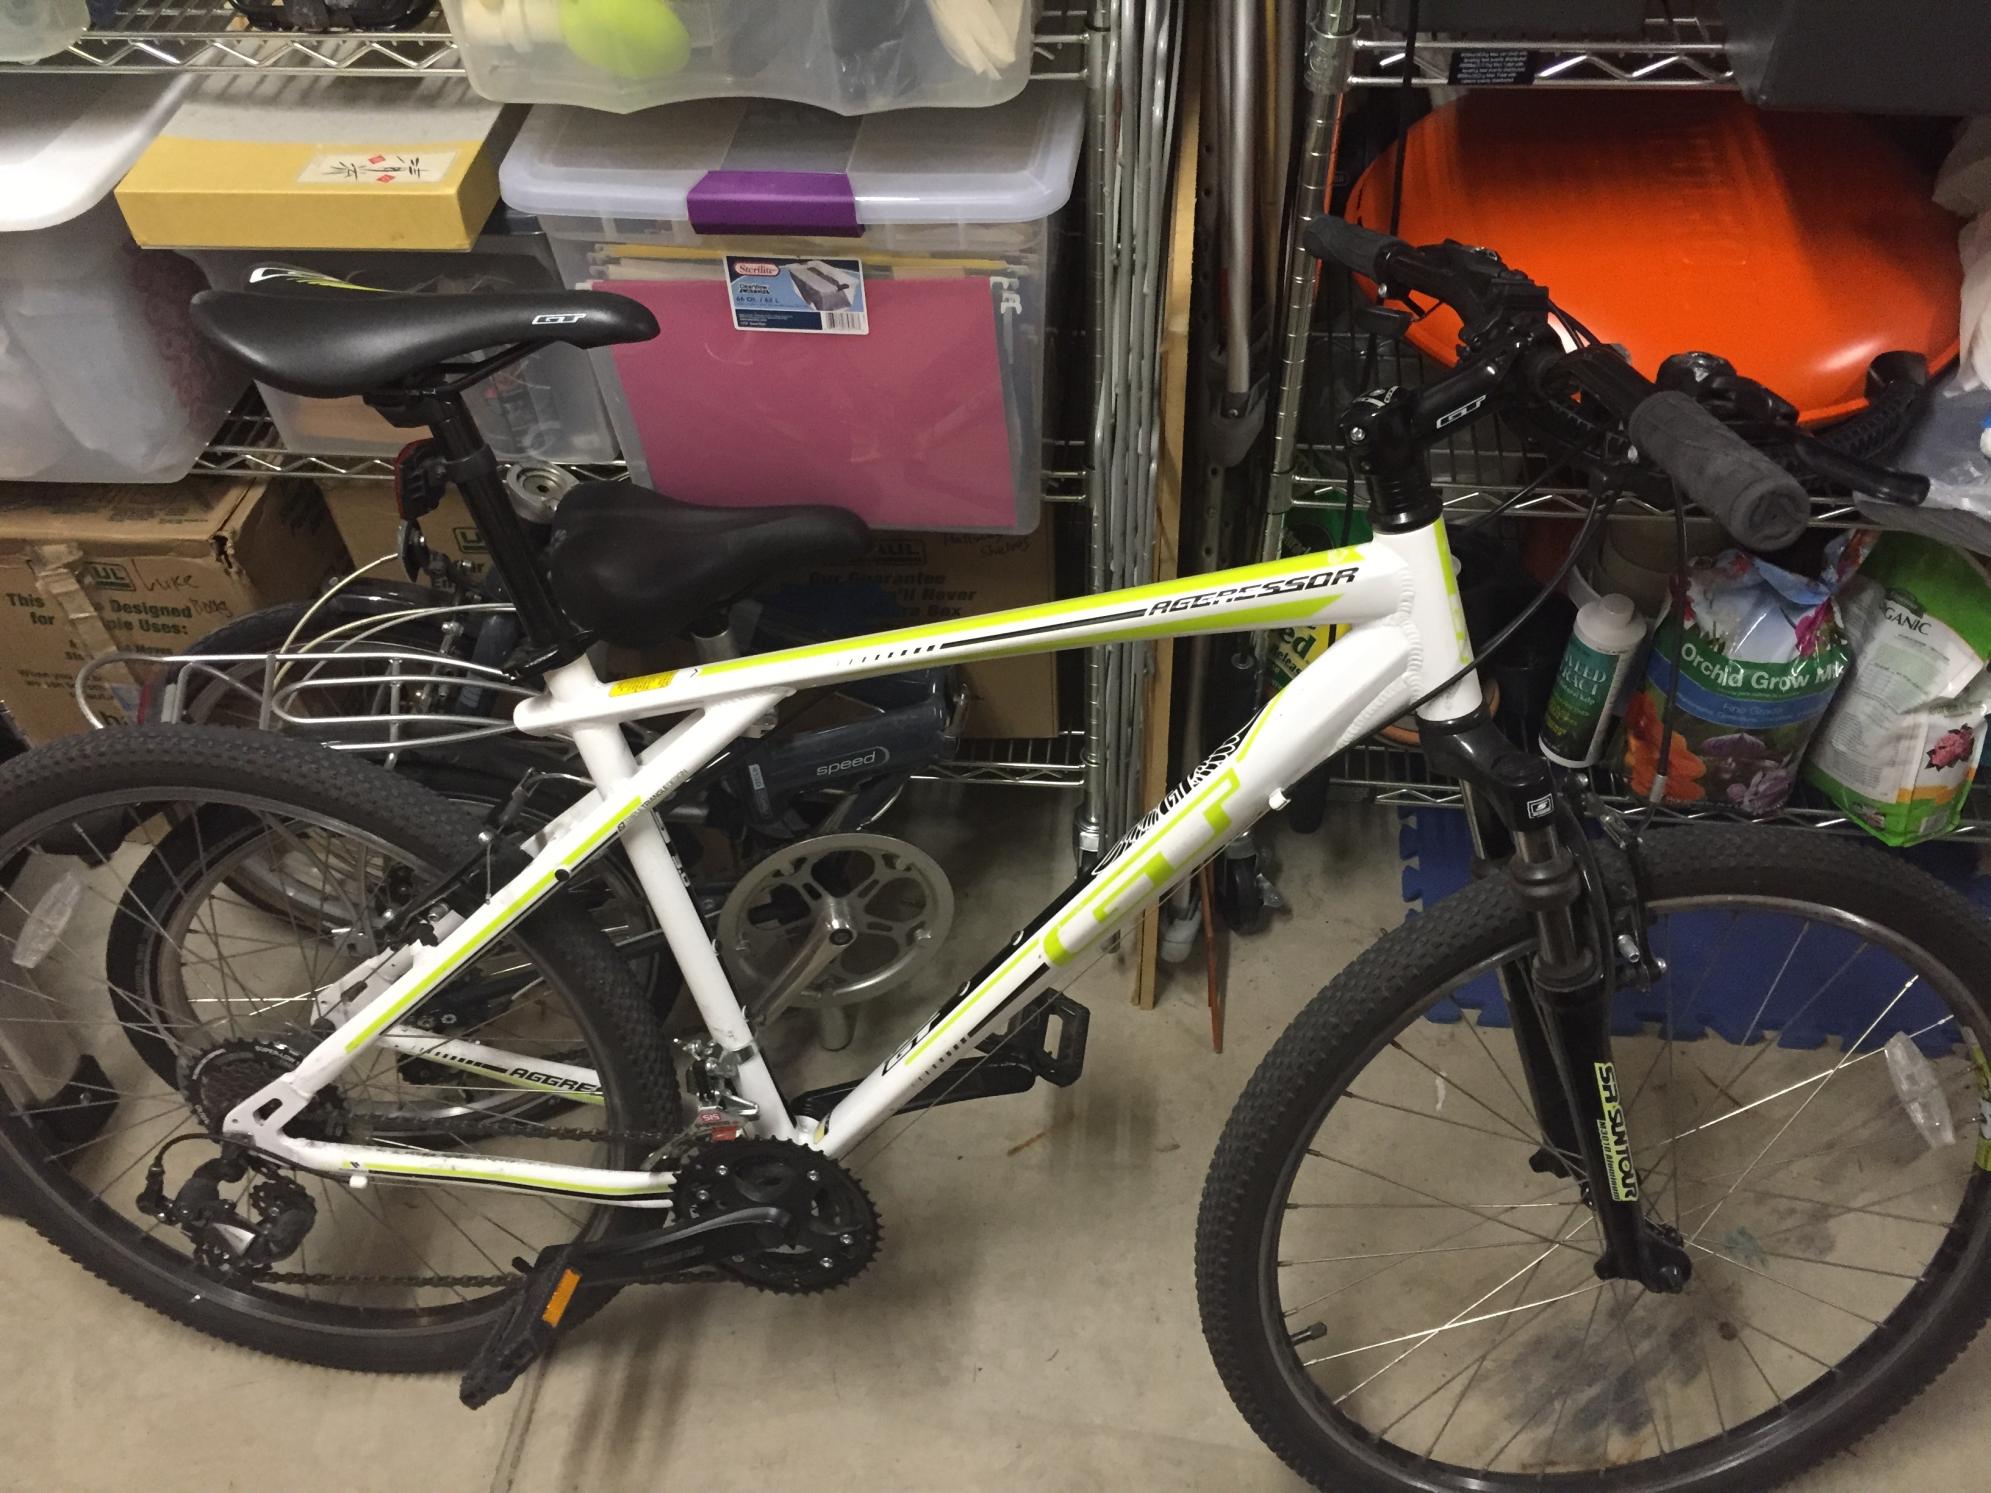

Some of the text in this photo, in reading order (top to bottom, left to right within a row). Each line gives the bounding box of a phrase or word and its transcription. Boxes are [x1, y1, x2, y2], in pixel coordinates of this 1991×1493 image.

[739, 264, 773, 274] Sterilite
[532, 313, 587, 325] GT
[1436, 394, 1487, 429] GT
[6, 593, 46, 608] This
[1149, 566, 1360, 617] AGGRESSOR
[30, 611, 56, 626] for
[109, 599, 192, 619] Designed
[139, 619, 189, 636] Uses:
[1681, 643, 1744, 688] Orchid
[1751, 671, 1809, 692] Grow
[817, 751, 876, 775] speed
[1607, 1107, 1638, 1200] SUNTOUR
